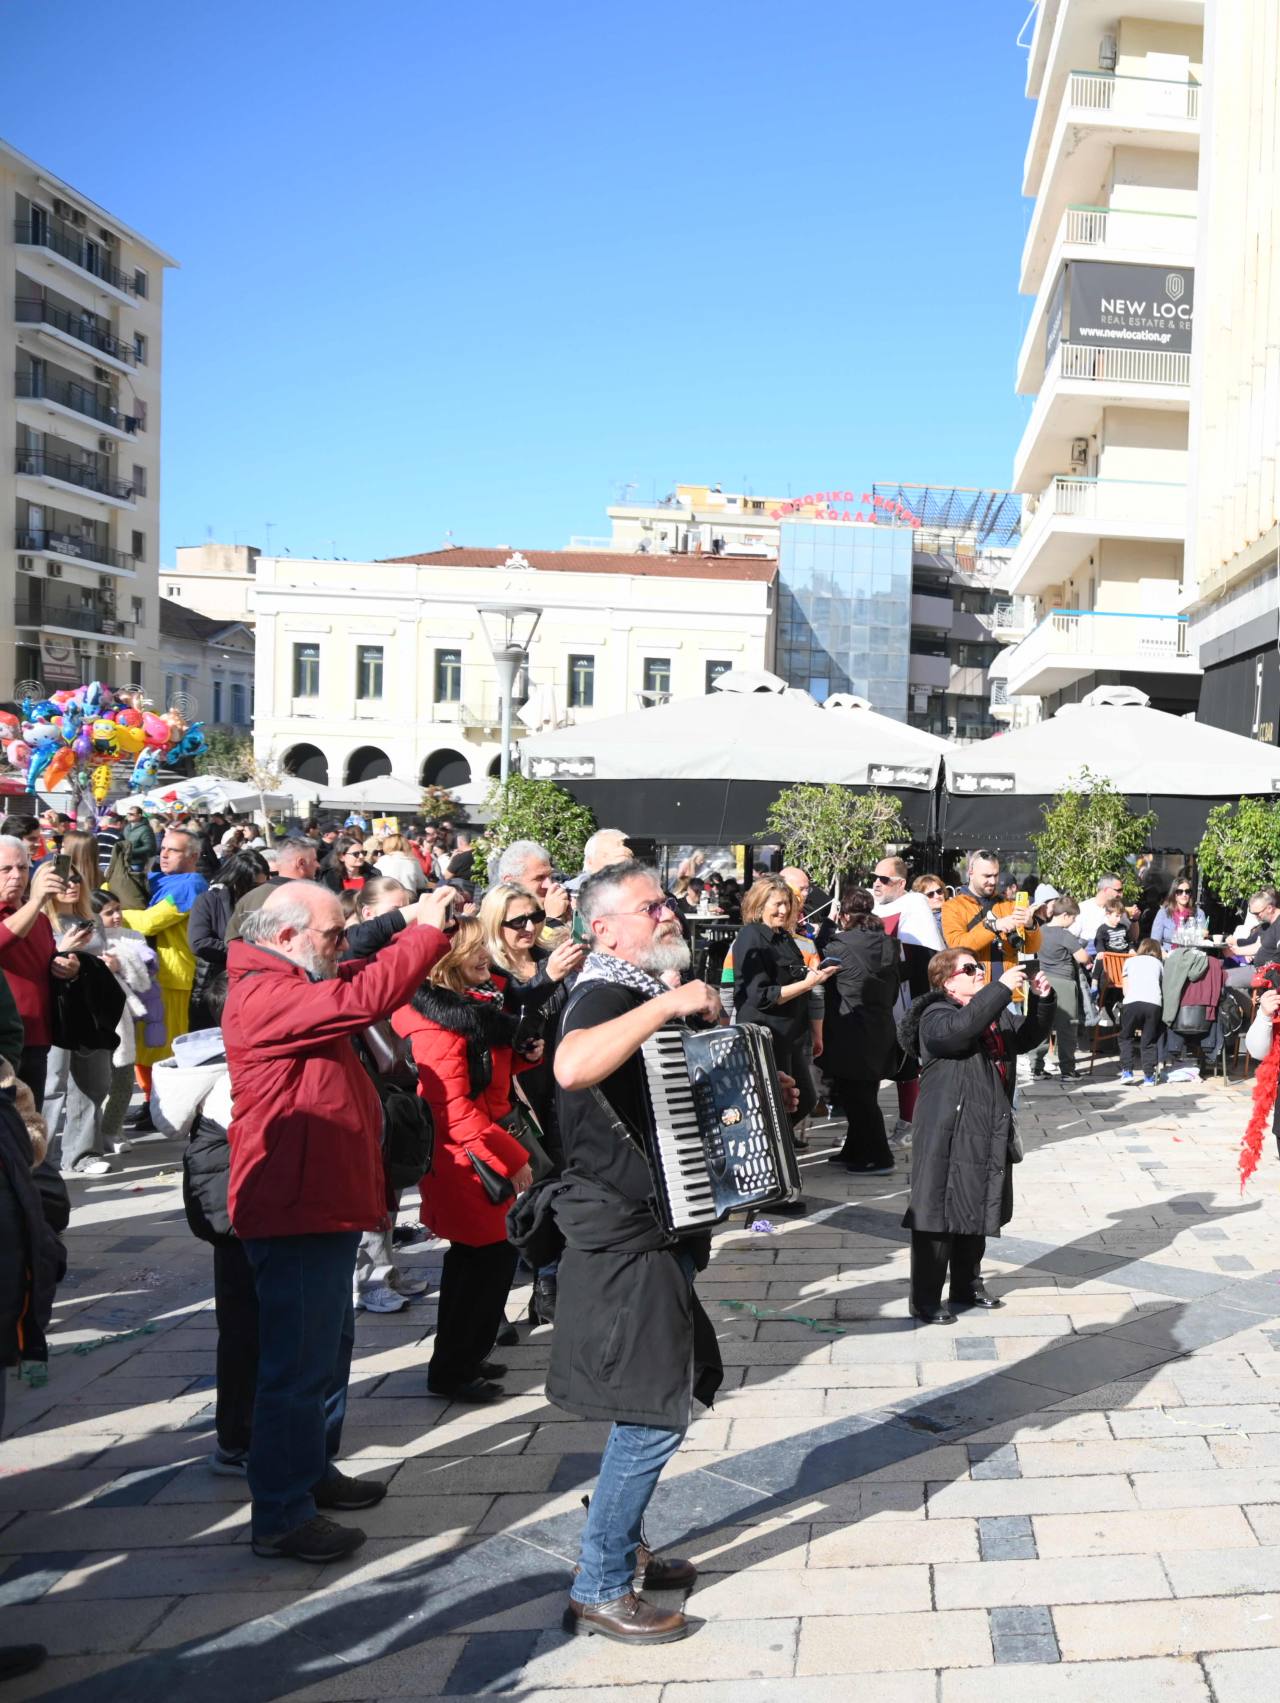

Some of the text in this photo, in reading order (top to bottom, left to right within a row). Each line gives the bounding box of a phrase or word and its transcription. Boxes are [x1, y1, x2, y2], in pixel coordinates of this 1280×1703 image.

[1100, 298, 1146, 315] NEW
[1100, 315, 1126, 326] REAL
[1128, 317, 1164, 328] ESTATE
[1165, 320, 1175, 329] &
[1079, 327, 1172, 344] www.newlocation.gr
